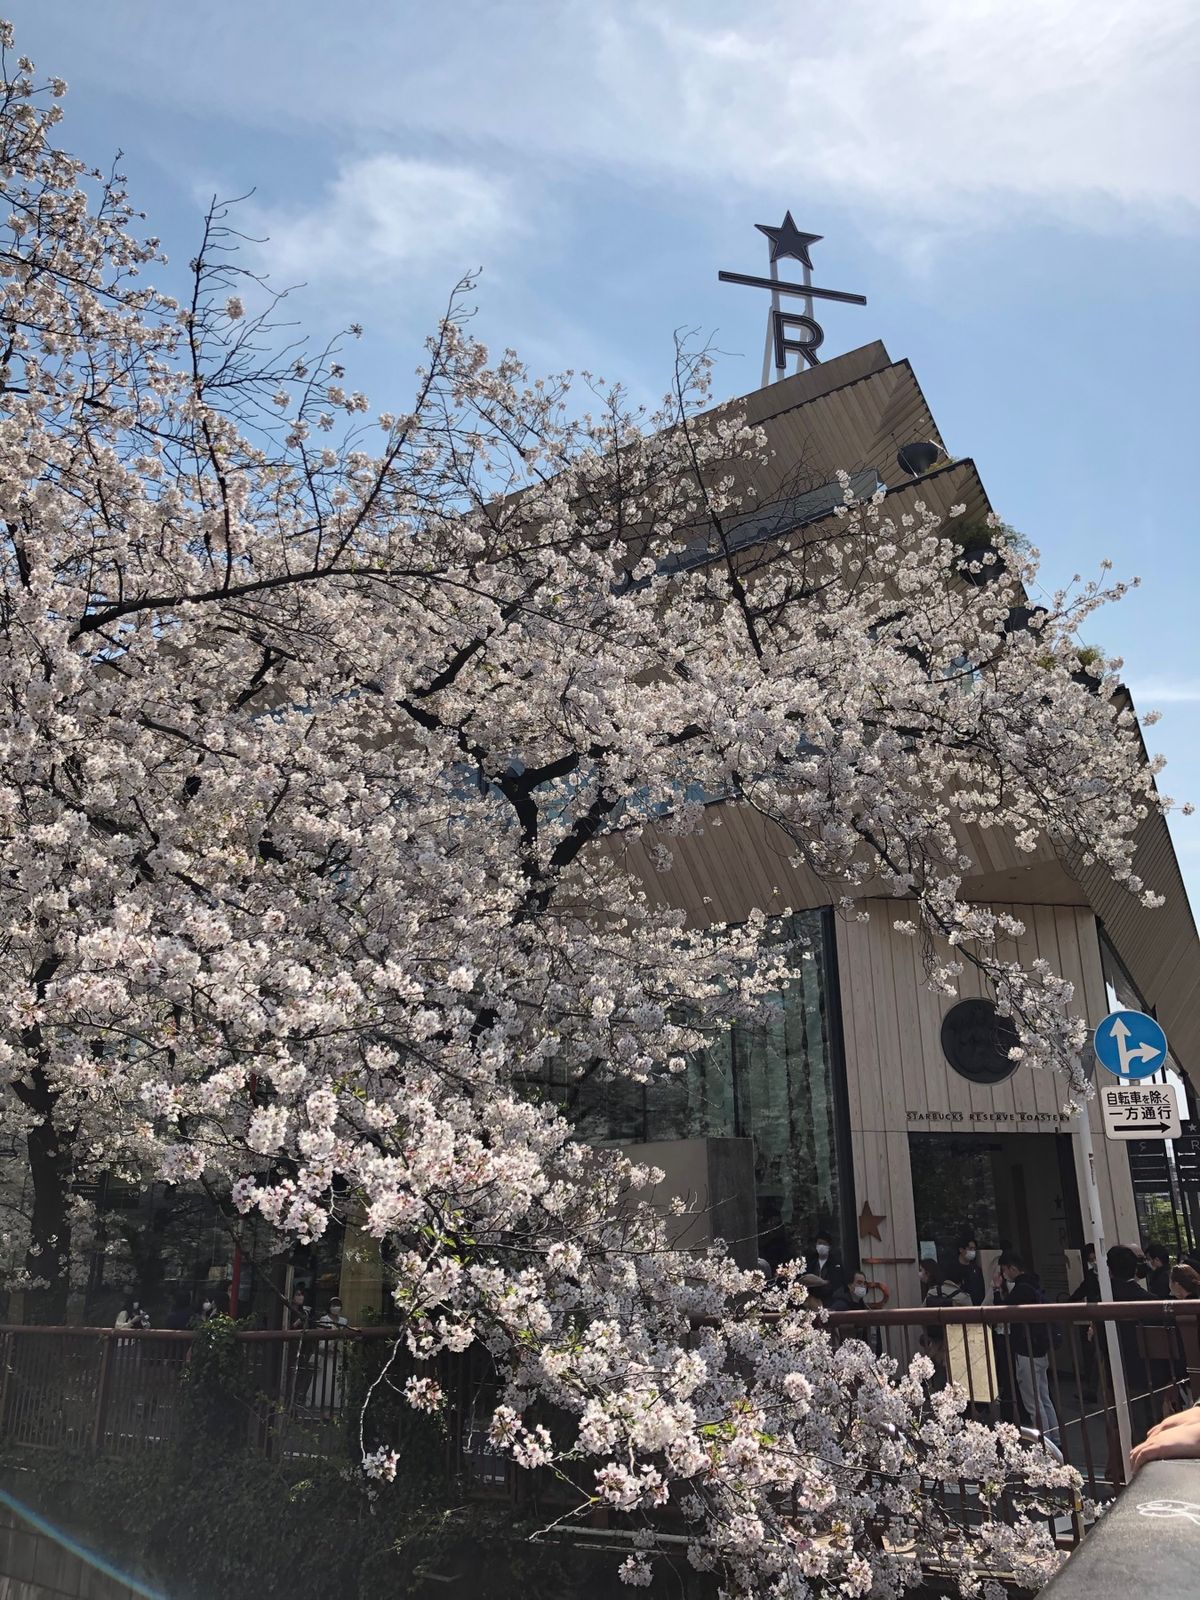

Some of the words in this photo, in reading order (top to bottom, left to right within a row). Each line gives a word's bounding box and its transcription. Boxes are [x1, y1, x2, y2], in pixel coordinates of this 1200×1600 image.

[773, 311, 824, 369] R
[1106, 1090, 1170, 1105] 自転車を除く
[906, 1112, 964, 1121] STARBUCKS
[969, 1113, 1015, 1121] RESERVE
[1020, 1113, 1070, 1121] ROASTERY
[1109, 1106, 1172, 1120] 一方通行
